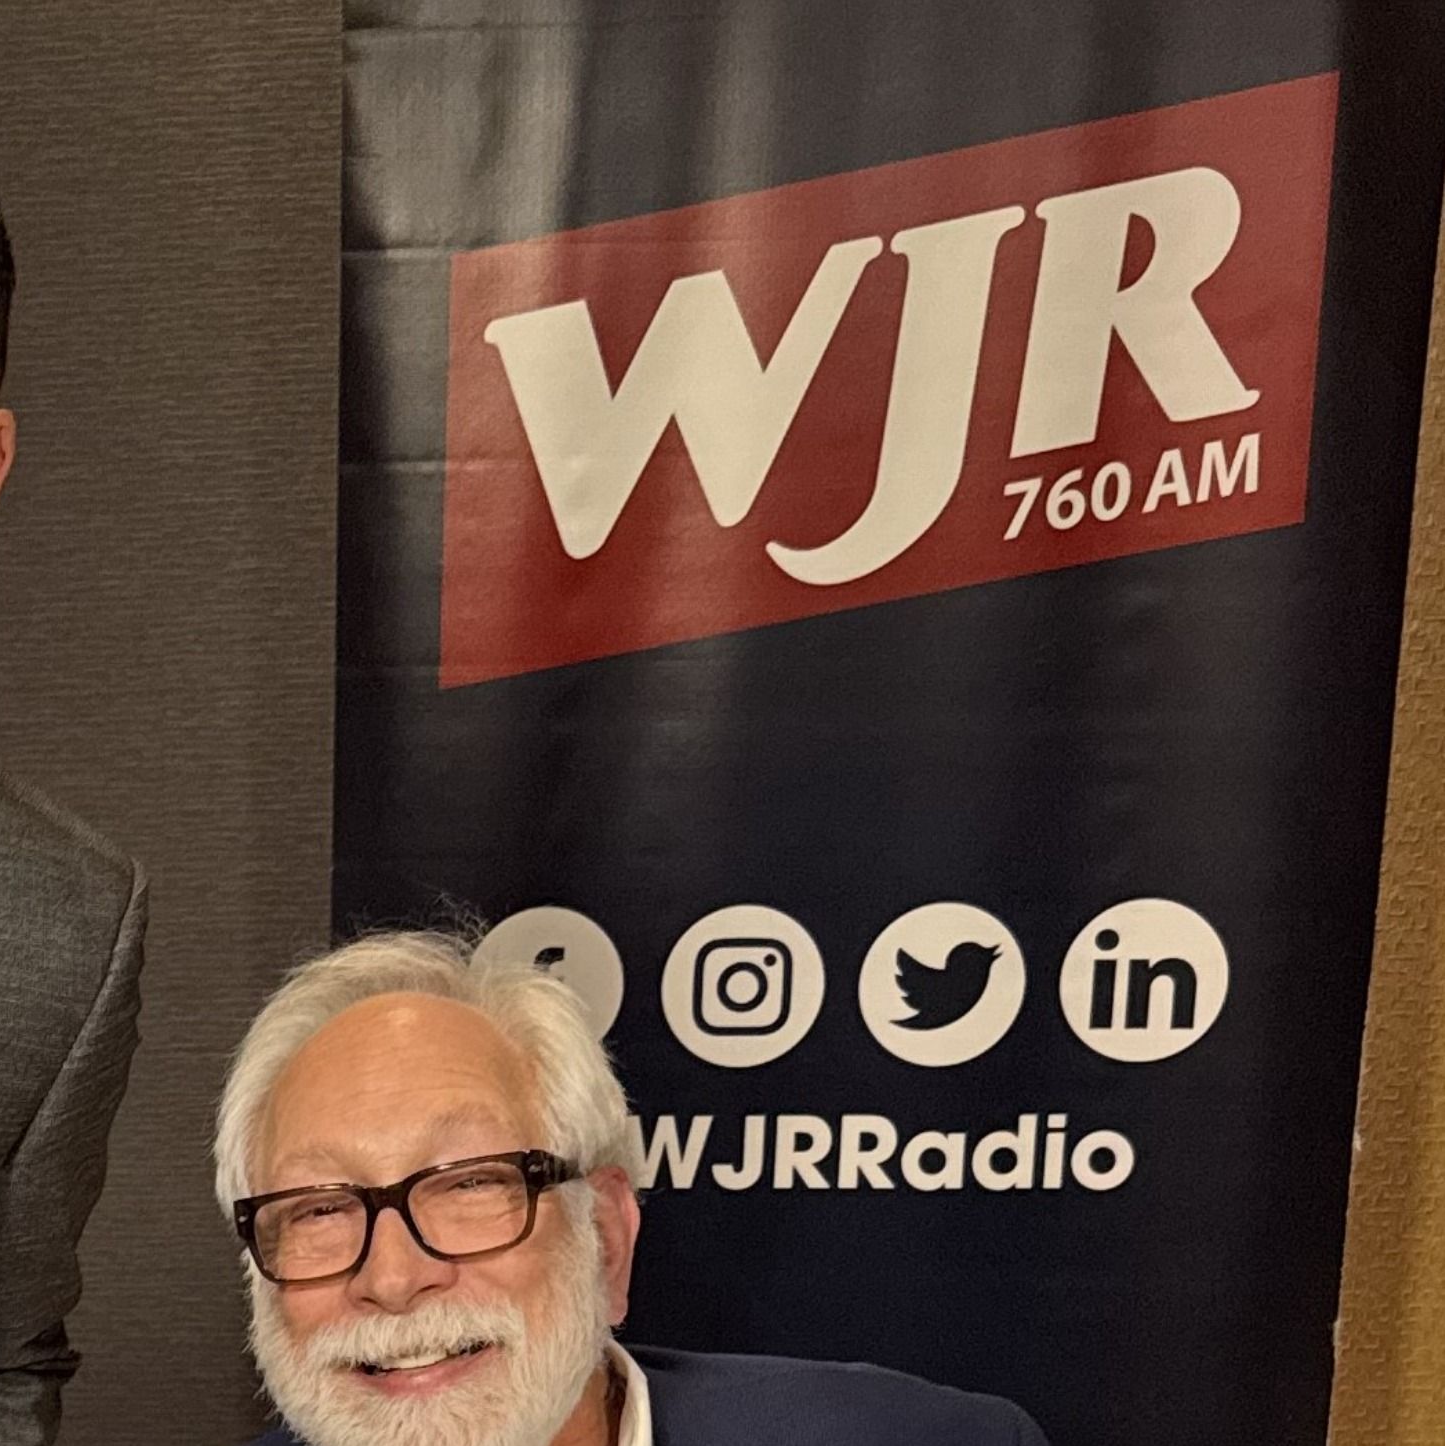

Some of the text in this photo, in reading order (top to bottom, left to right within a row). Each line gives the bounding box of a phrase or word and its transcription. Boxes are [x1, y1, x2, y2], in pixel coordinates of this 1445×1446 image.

[483, 166, 1261, 587] WJR
[1001, 432, 1263, 541] 760 AM
